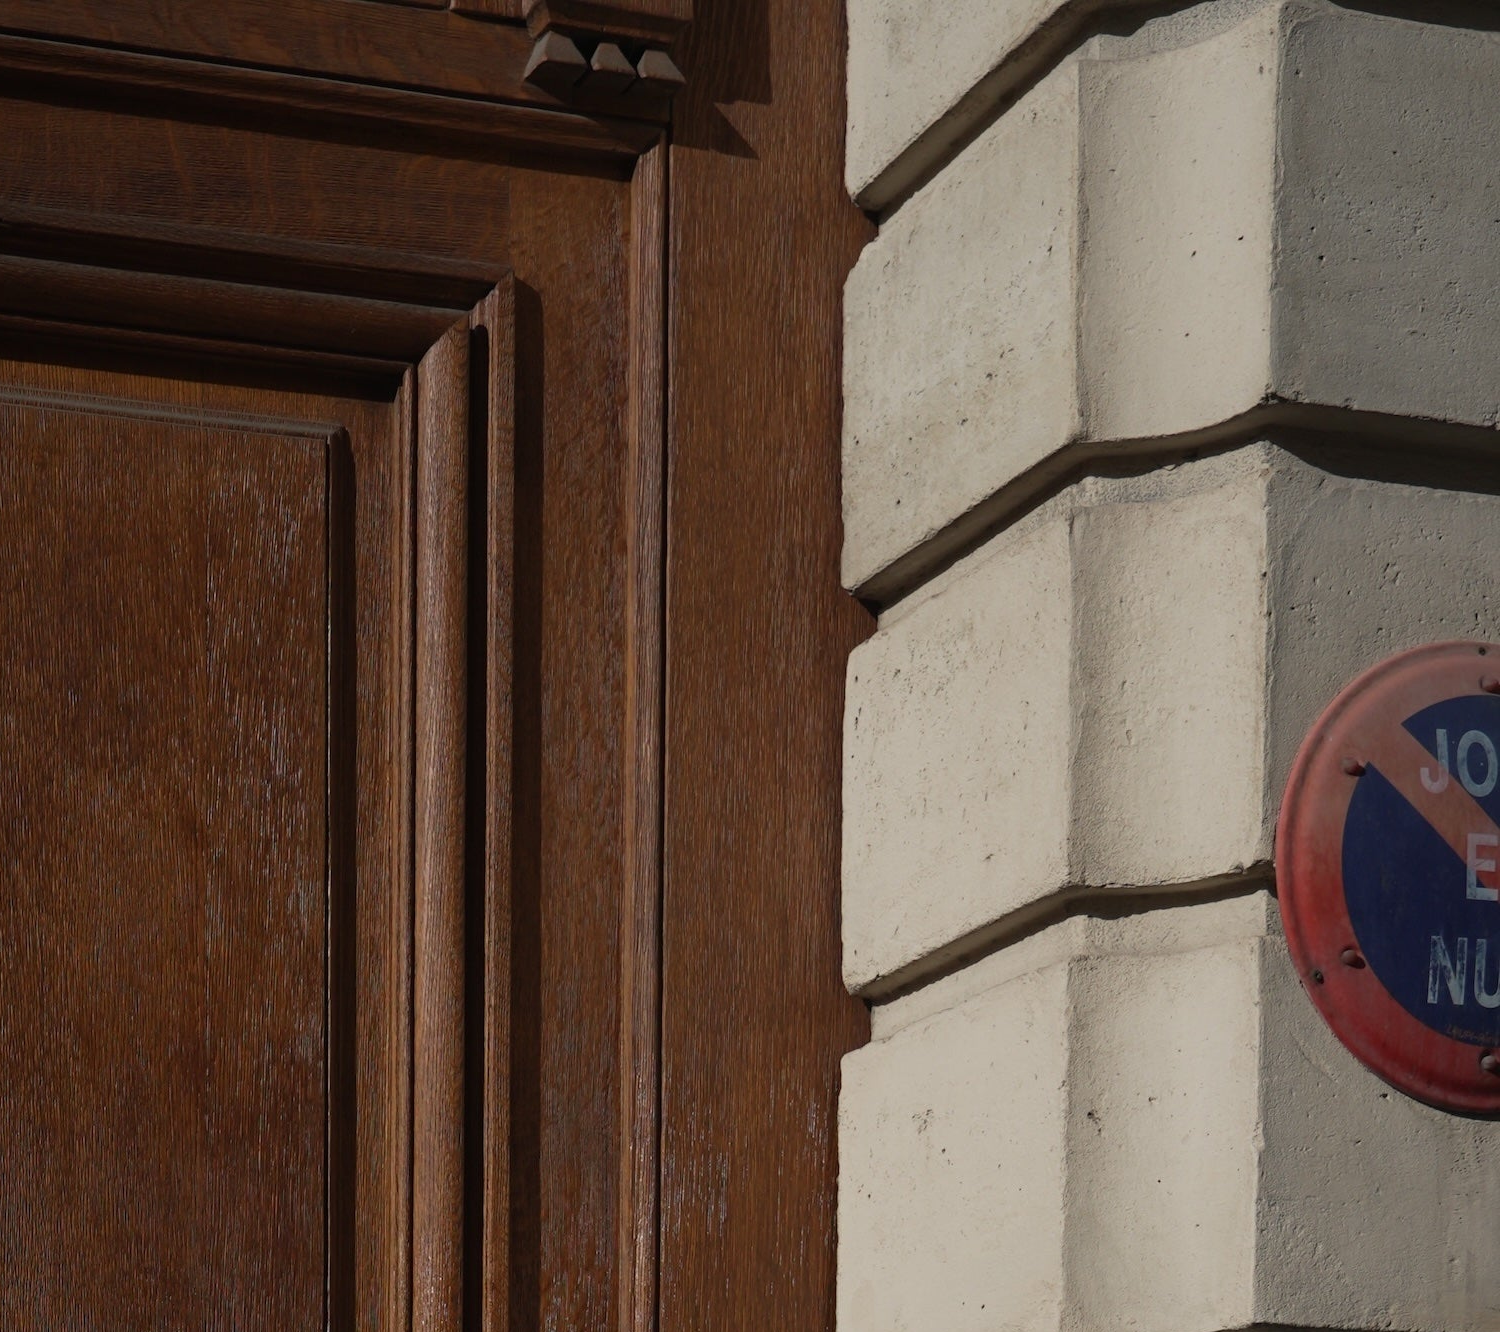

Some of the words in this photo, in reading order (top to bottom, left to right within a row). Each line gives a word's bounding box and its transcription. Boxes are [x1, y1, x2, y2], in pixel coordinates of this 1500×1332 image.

[1420, 728, 1499, 798] JO
[1466, 833, 1499, 901] E
[1427, 935, 1500, 1009] NU
